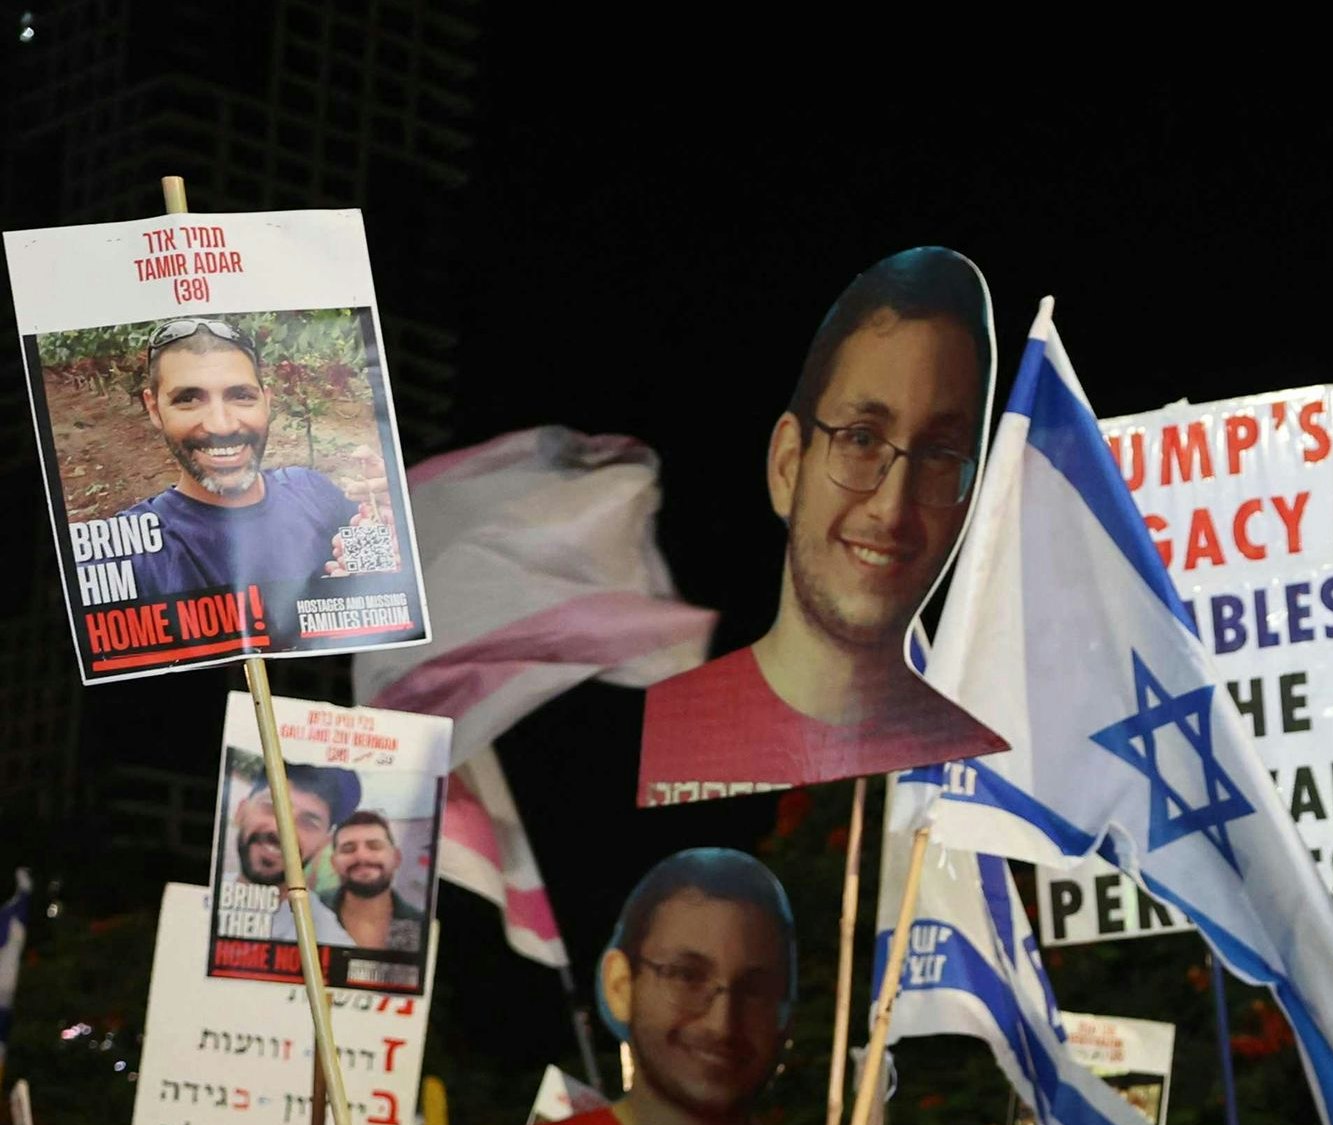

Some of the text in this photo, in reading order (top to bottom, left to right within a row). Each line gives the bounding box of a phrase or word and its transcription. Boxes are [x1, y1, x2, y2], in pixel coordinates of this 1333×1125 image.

[143, 226, 226, 253] תמיר אדר
[134, 251, 244, 281] TAMIR ADAR
[174, 276, 210, 304] (38)
[1106, 401, 1331, 492] UMP'S
[69, 512, 163, 563] BRING
[1144, 491, 1311, 570] GACY
[76, 559, 138, 606] HIM
[86, 585, 265, 654] HOME NOW!
[297, 598, 345, 615] HOSTAGES
[299, 604, 409, 632] FAMILIES FORUM
[220, 881, 281, 911] BRING
